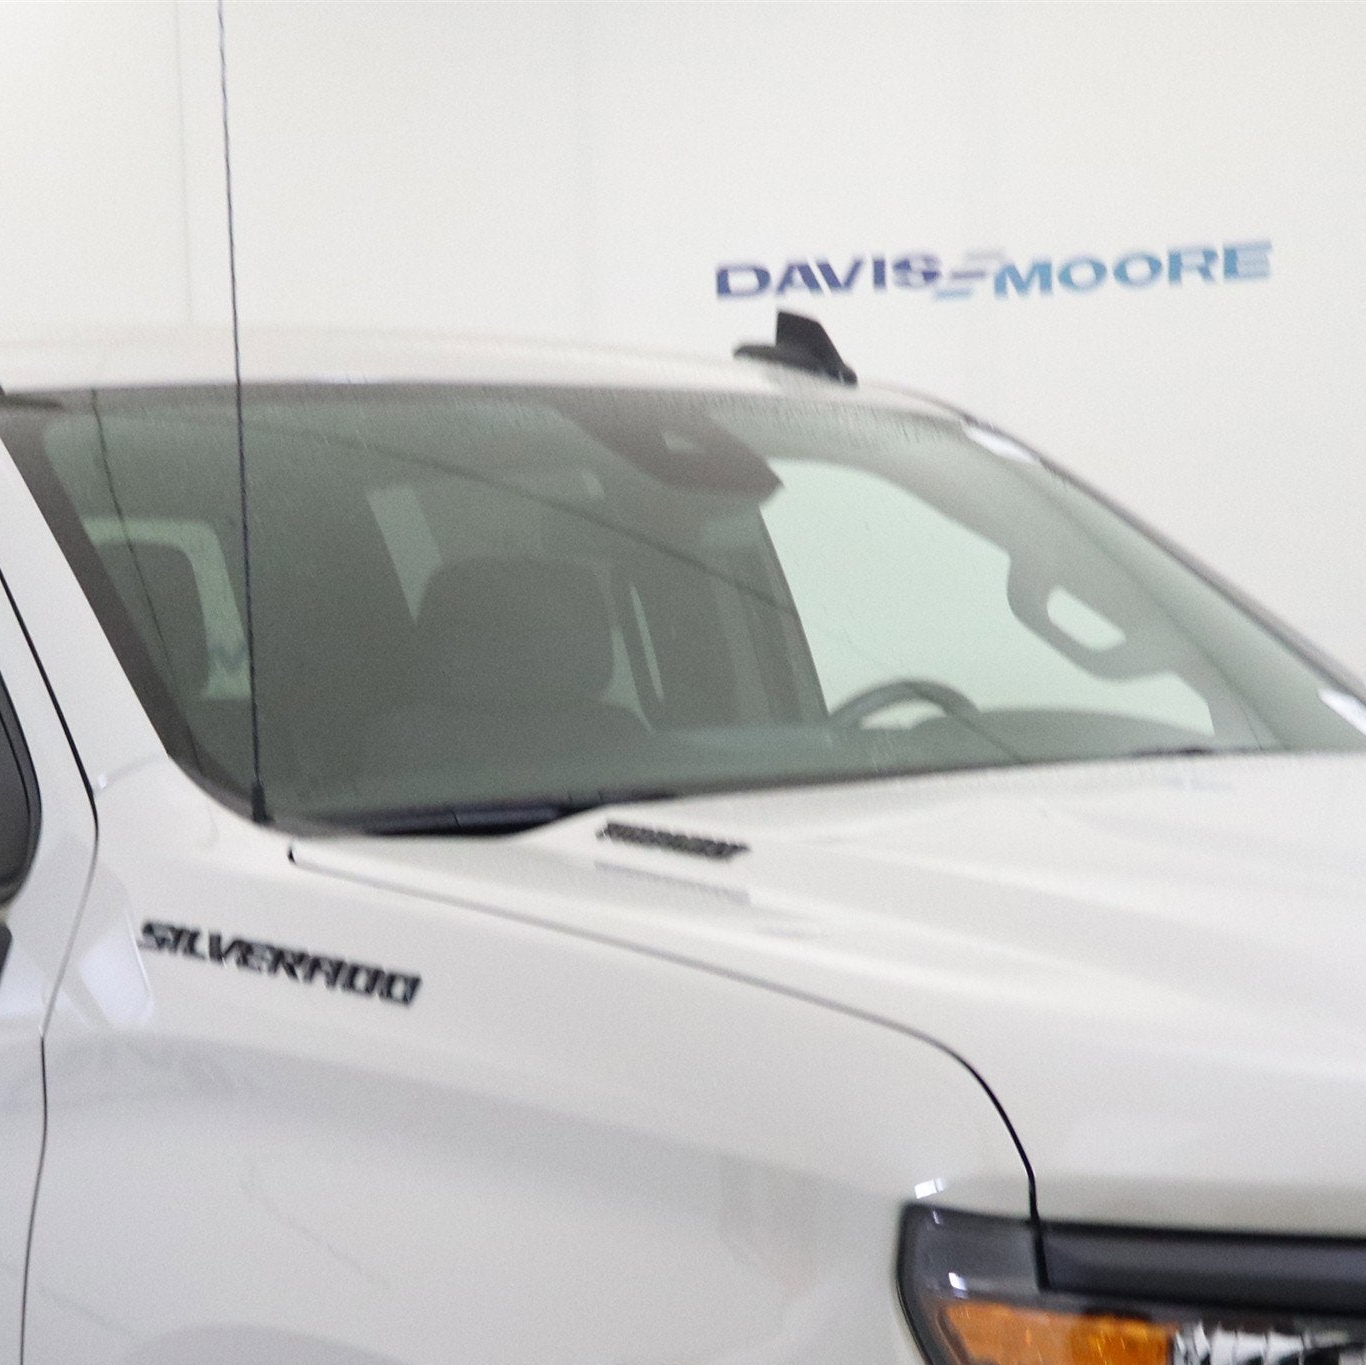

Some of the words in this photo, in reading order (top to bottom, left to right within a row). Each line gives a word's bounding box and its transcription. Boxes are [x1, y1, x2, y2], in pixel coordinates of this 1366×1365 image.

[715, 250, 942, 299] DAVIS
[992, 238, 1272, 300] MOORE
[139, 920, 422, 1006] SILVERADO
